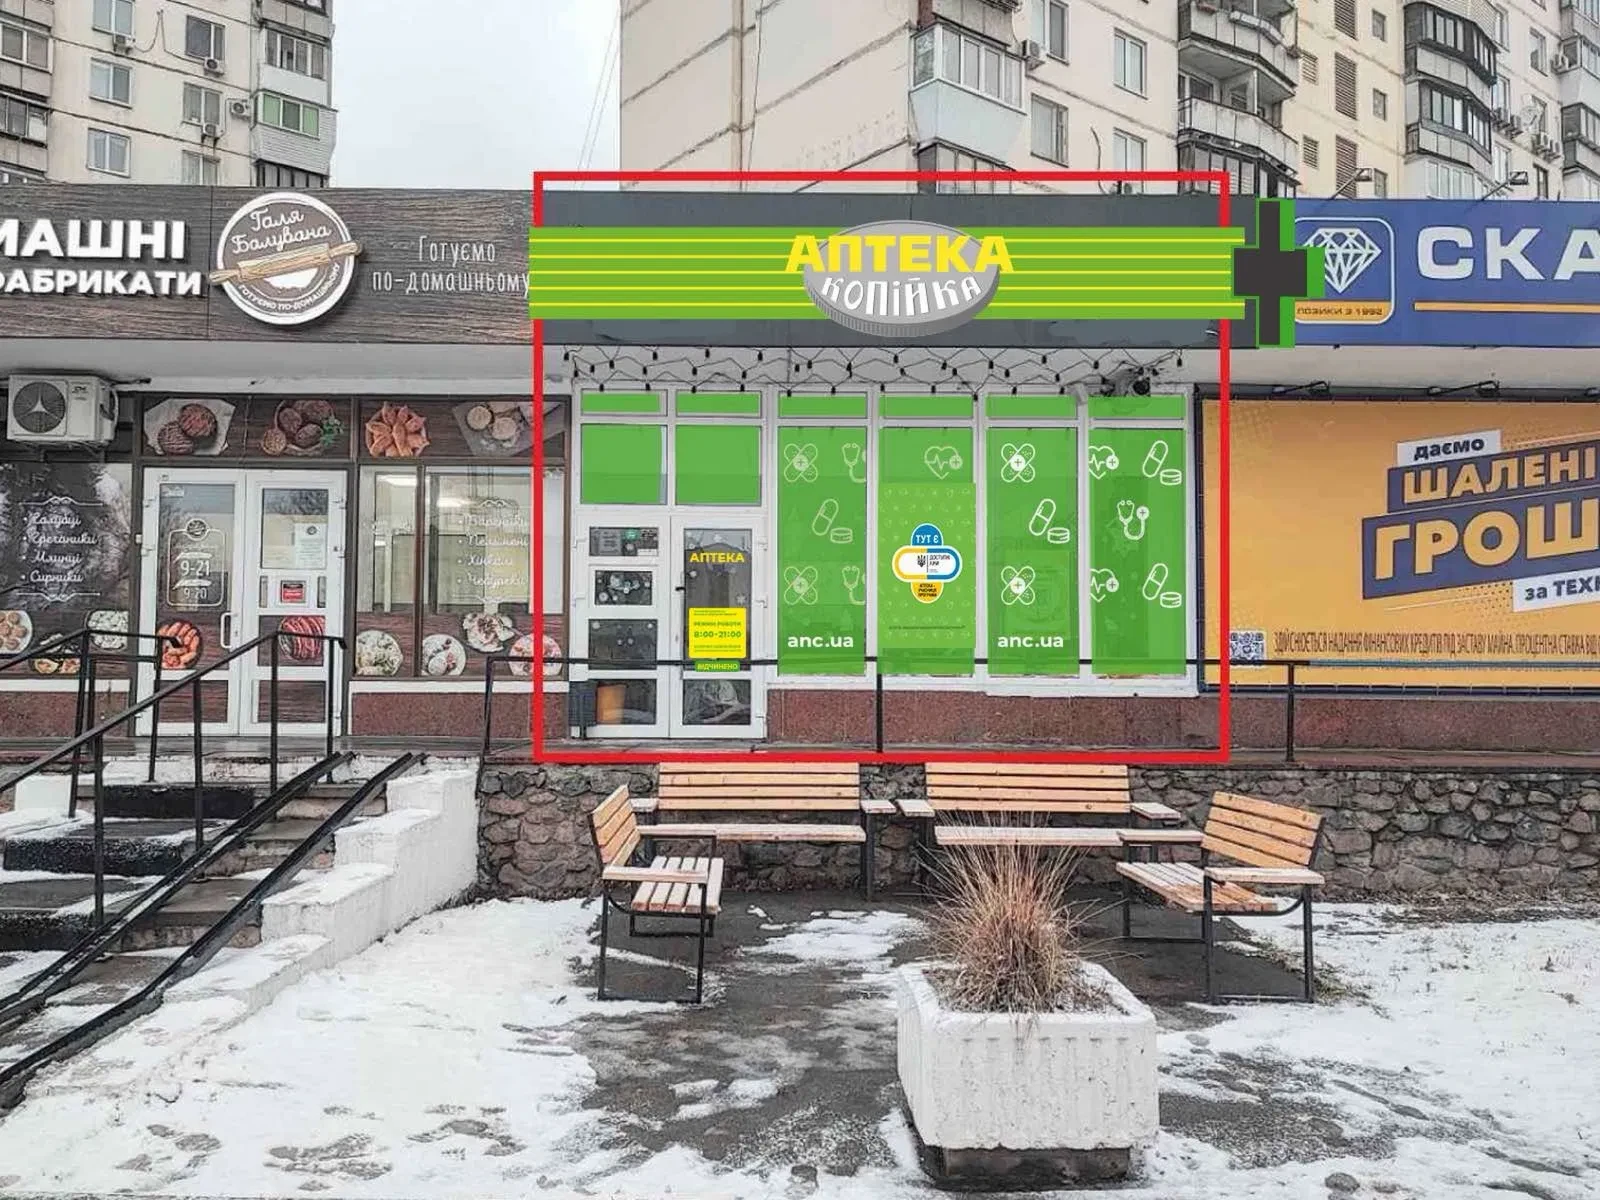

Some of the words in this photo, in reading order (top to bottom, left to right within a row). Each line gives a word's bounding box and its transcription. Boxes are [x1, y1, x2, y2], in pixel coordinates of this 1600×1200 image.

[250, 207, 304, 232] Галя
[231, 224, 333, 255] Балувана
[418, 235, 496, 268] Готуємо
[784, 234, 1015, 273] АПТЕКА
[0, 268, 202, 296] АБРИКАТИ
[372, 271, 530, 299] по-домашньому
[1413, 438, 1486, 461] даємо
[1404, 447, 1596, 505] ШАЛЕНІ
[916, 534, 932, 544] ТУТ
[1375, 497, 1600, 580] ГРОШ
[180, 560, 210, 577] 9-21
[690, 552, 745, 563] АПТЕКА
[1524, 586, 1547, 601] за
[787, 635, 854, 648] anc.ua
[997, 635, 1064, 648] anc.ua
